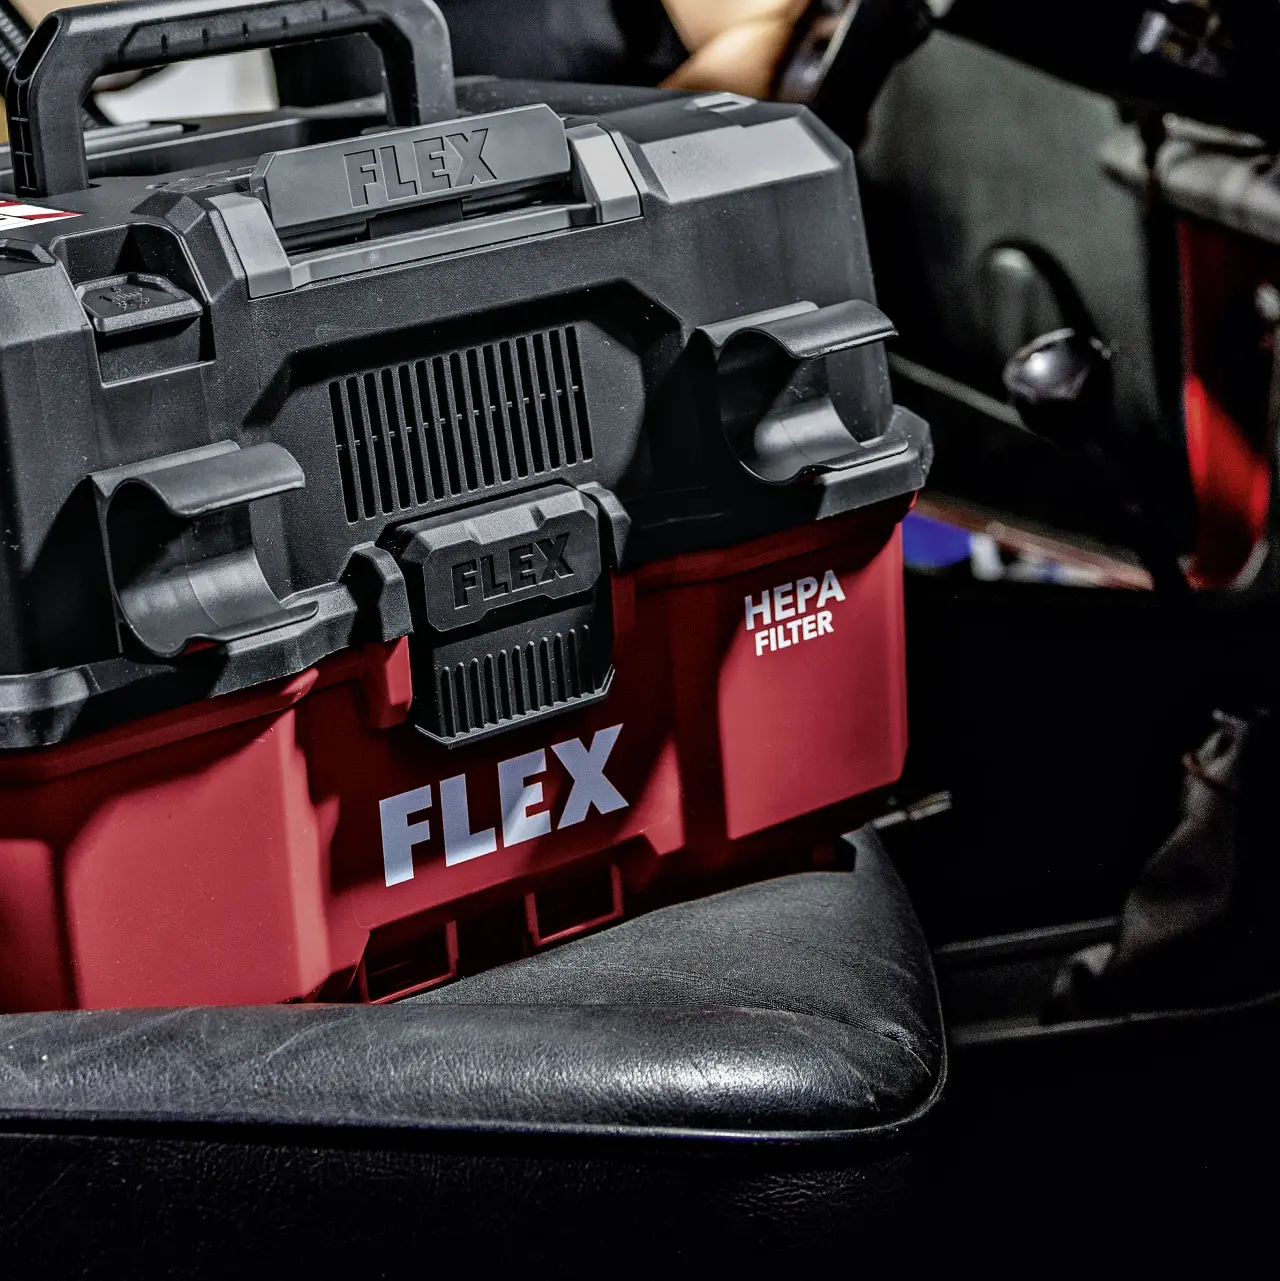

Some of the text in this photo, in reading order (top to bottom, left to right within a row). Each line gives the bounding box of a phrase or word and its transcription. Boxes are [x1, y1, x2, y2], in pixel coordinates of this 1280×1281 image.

[344, 128, 497, 208] FLEX
[451, 532, 575, 610] FLEX
[744, 569, 846, 631] HEPA
[754, 610, 835, 656] FILTER
[379, 723, 629, 887] FLEX
